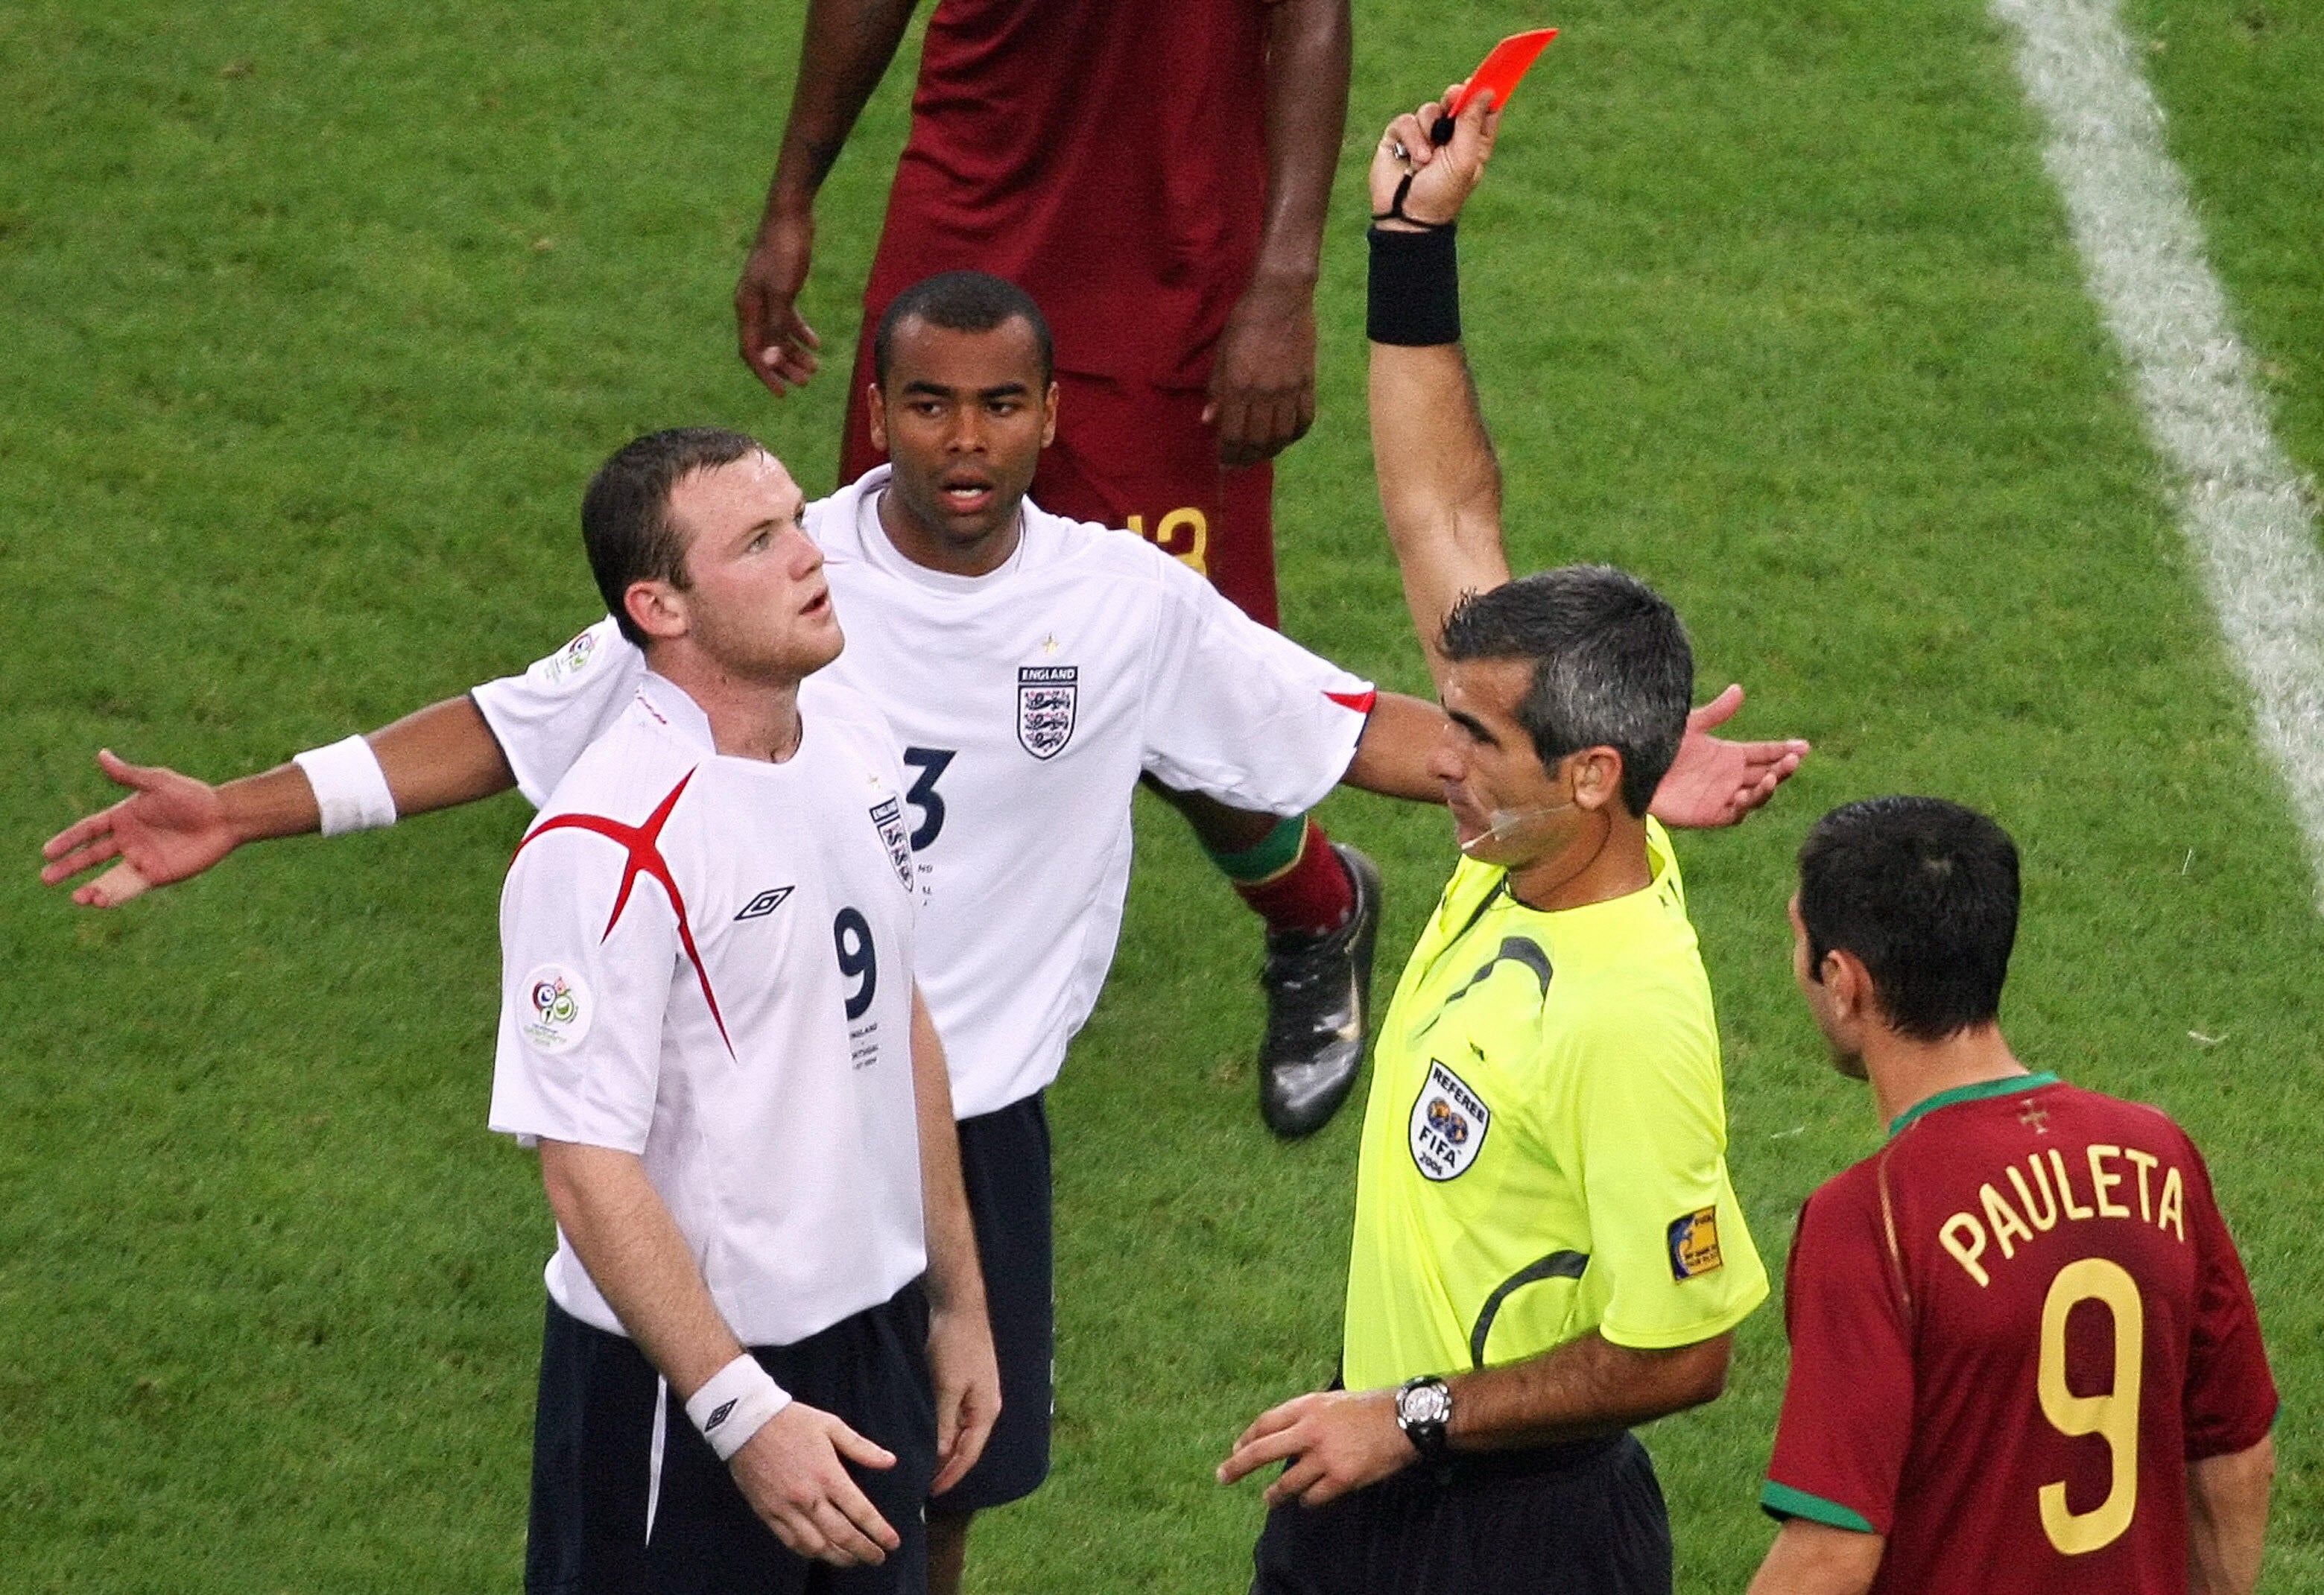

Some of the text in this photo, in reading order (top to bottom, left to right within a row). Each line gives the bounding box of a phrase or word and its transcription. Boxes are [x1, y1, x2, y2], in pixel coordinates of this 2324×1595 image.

[1127, 507, 1207, 577] 3
[1022, 669, 1074, 679] ENGLAND
[903, 747, 957, 852] 3
[834, 907, 876, 1021] 9
[1432, 1068, 1485, 1123] REFEREE
[1419, 1126, 1455, 1168] FIFA
[1419, 1152, 1443, 1176] 2006
[1939, 1144, 2184, 1287] PAULETA
[2039, 1258, 2143, 1556] 9
